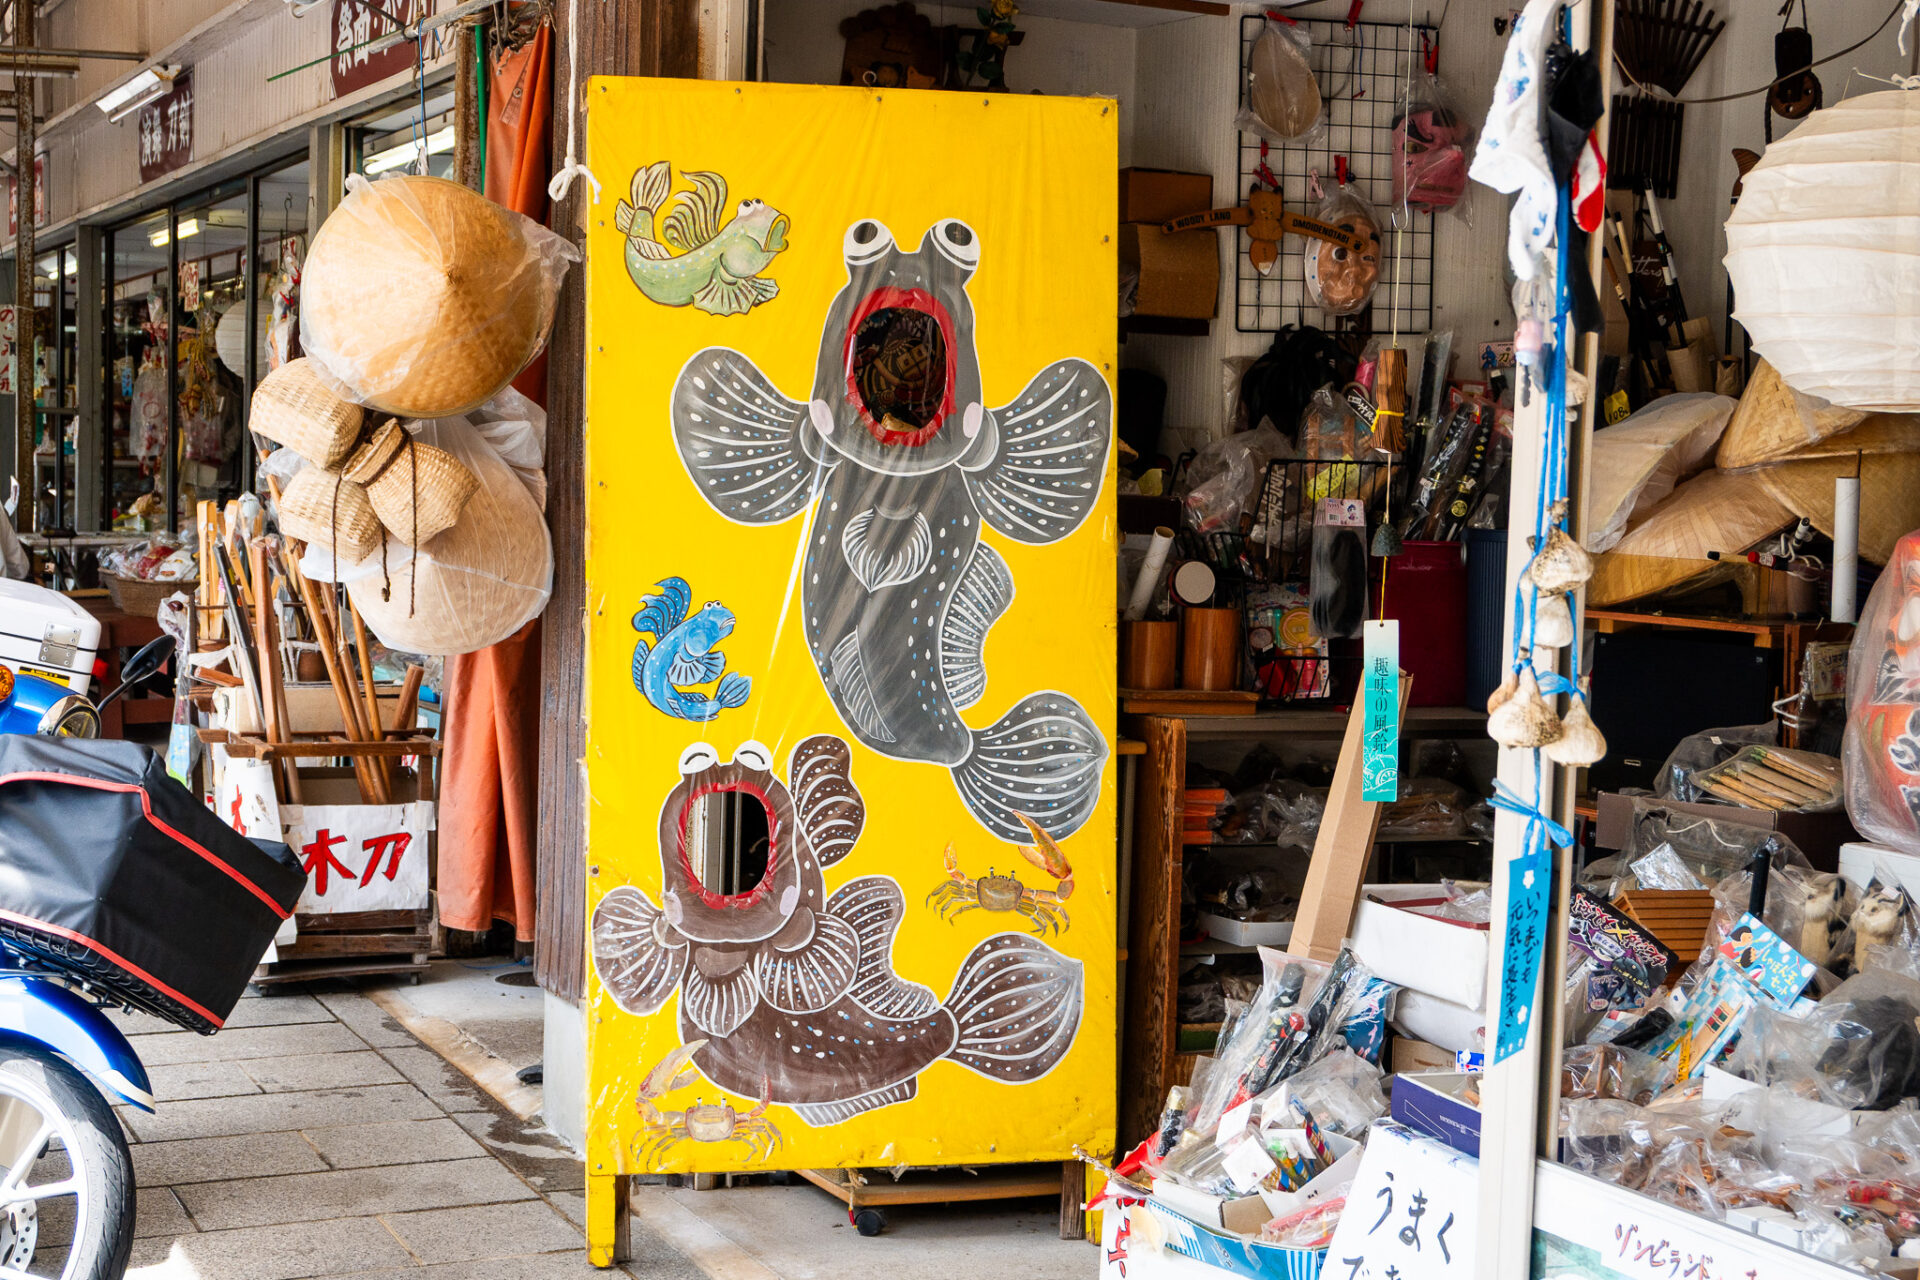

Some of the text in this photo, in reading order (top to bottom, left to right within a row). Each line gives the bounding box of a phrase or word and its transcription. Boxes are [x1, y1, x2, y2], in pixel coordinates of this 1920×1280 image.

[1176, 211, 1231, 229] WOODY LAND
[1373, 656, 1389, 753] 趣味の風鈴
[301, 828, 413, 897] 木刀
[1521, 891, 1541, 984] いつまでも
[1761, 948, 1799, 986] しゃぼん玉
[1770, 975, 1788, 996] セット
[1367, 1171, 1454, 1265] うまく
